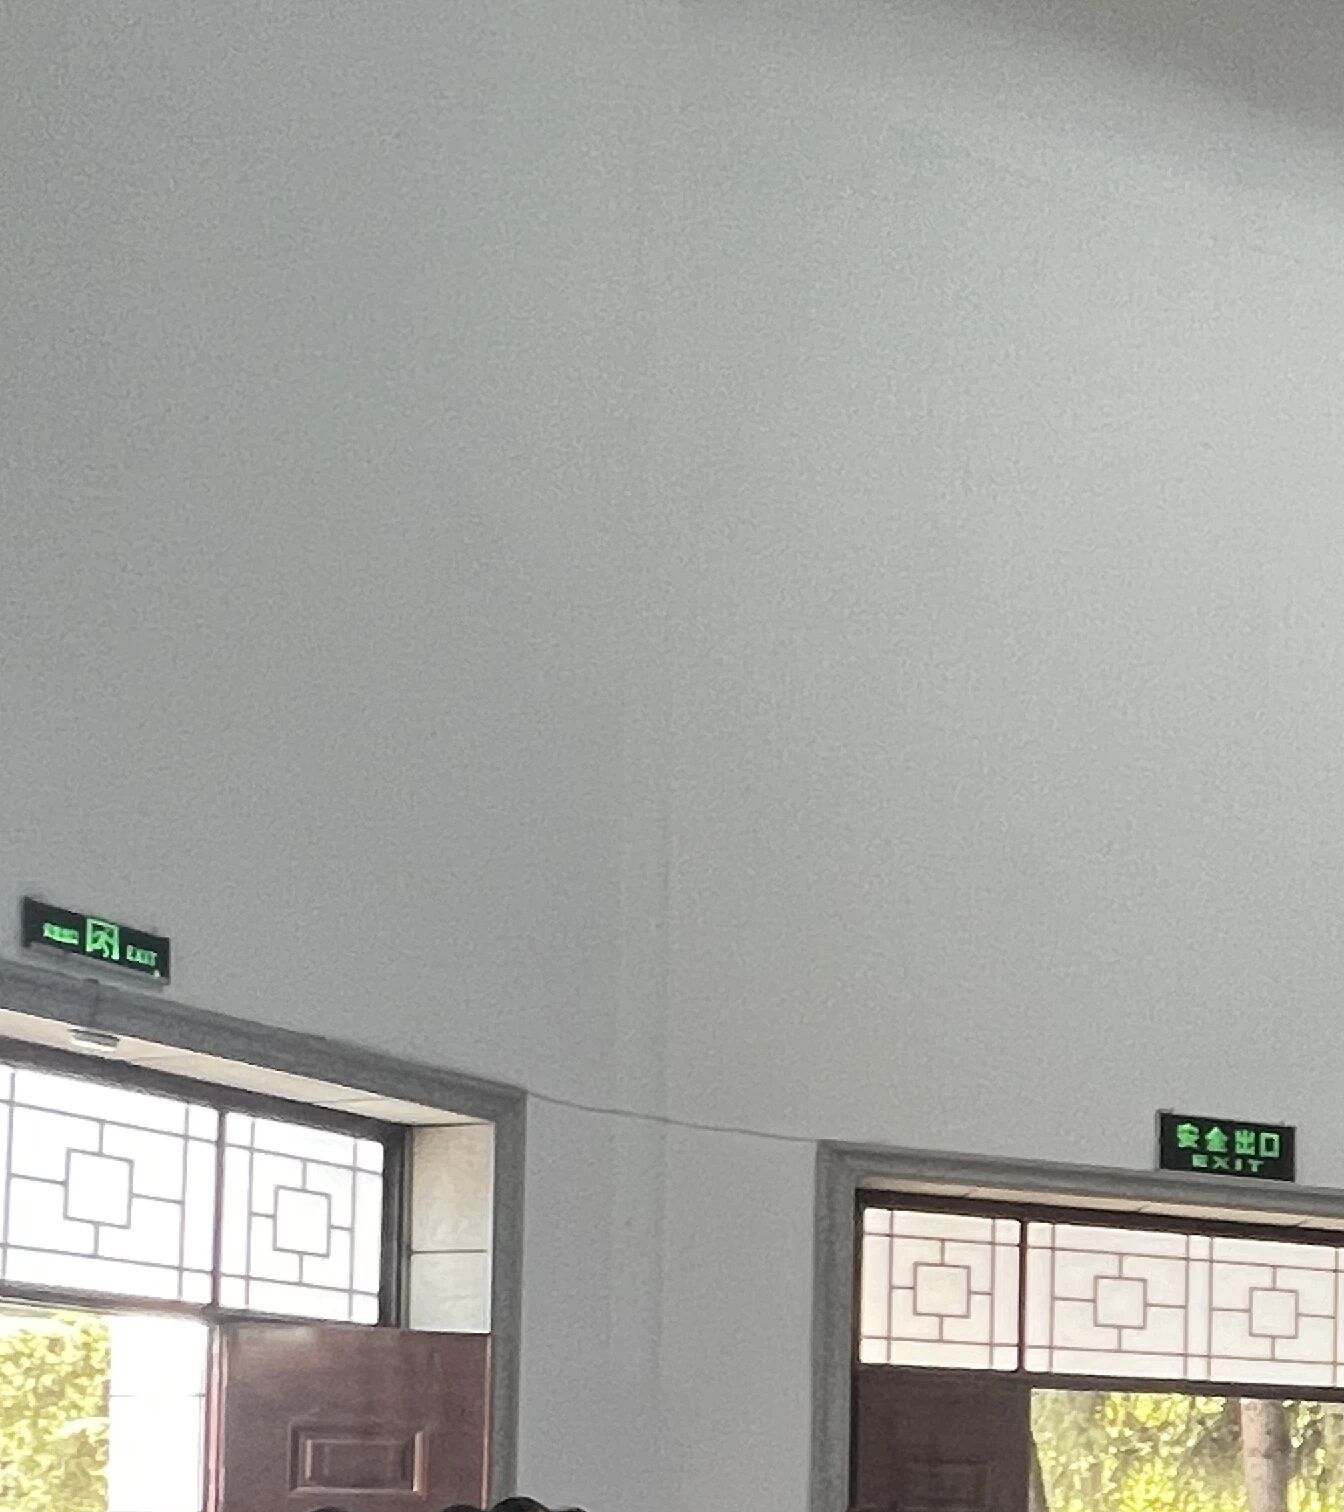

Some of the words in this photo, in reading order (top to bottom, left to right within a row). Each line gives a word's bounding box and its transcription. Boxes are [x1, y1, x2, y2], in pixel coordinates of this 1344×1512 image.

[1176, 1122, 1280, 1158] 安全出口
[1192, 1154, 1264, 1172] EXIT
